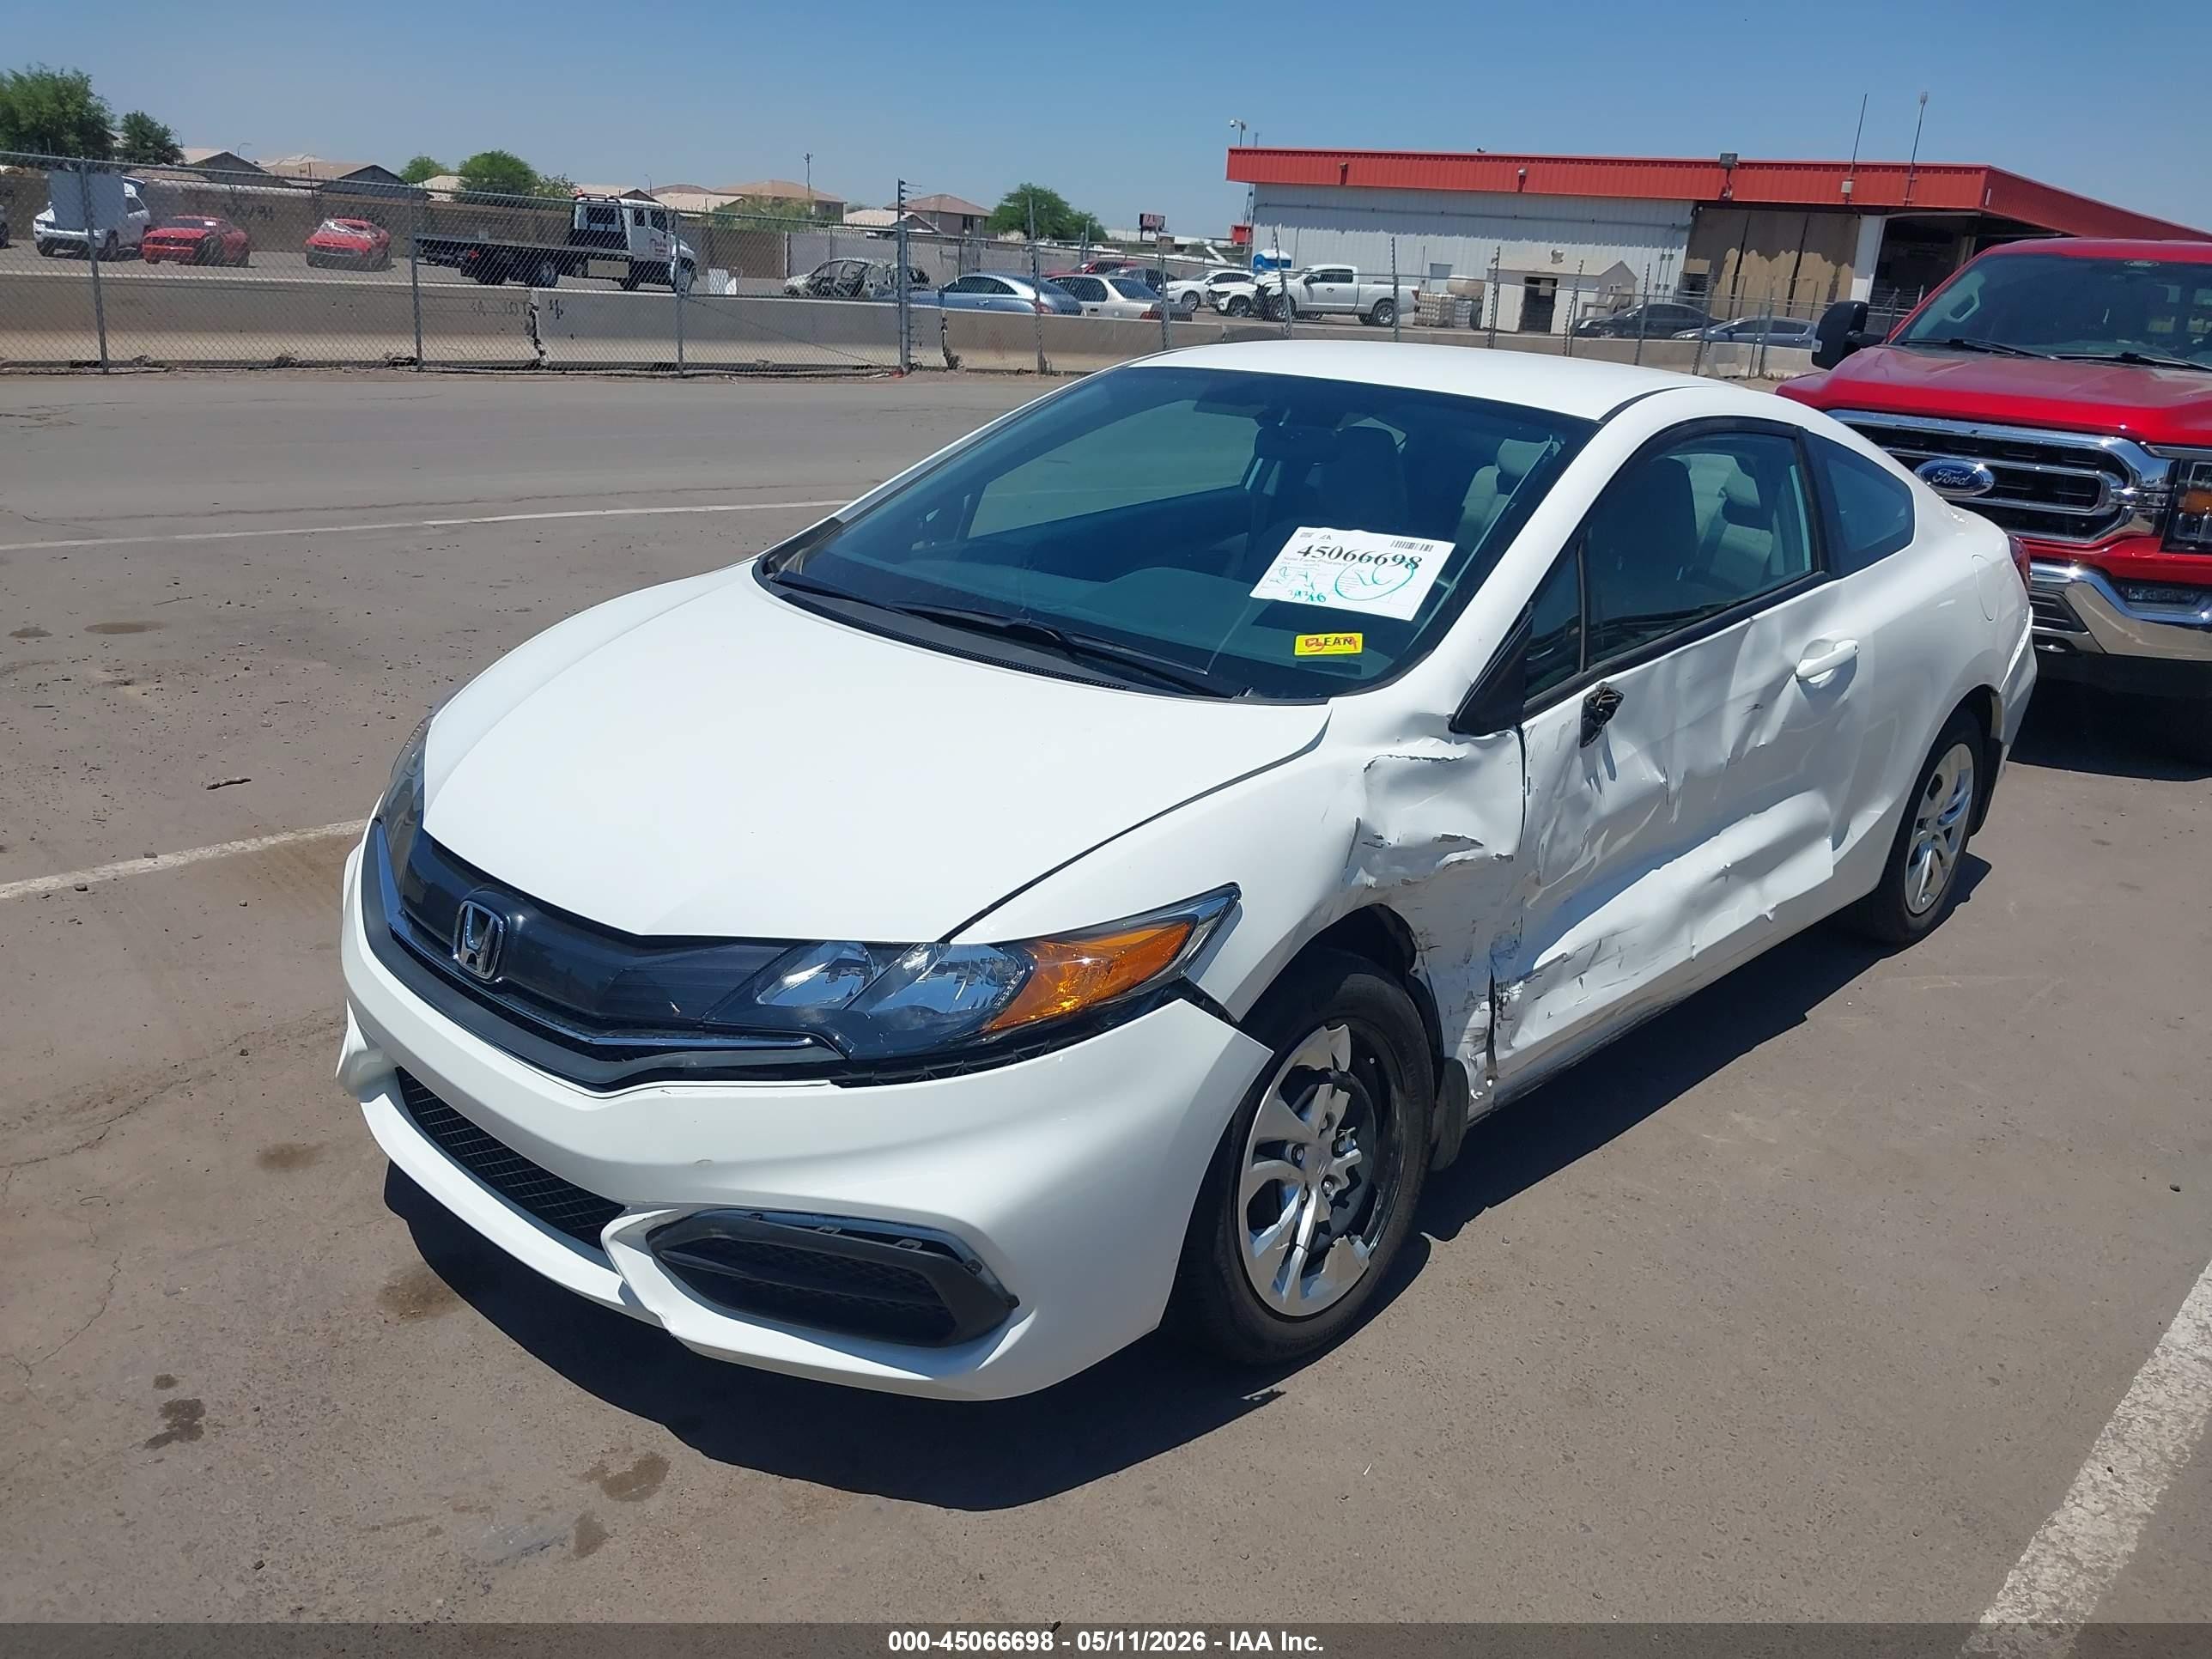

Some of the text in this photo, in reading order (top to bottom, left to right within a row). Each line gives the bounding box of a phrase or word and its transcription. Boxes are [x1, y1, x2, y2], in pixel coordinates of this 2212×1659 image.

[1931, 468, 1972, 486] Ford
[1297, 544, 1423, 570] 45066698
[1304, 637, 1354, 647] CLEAN
